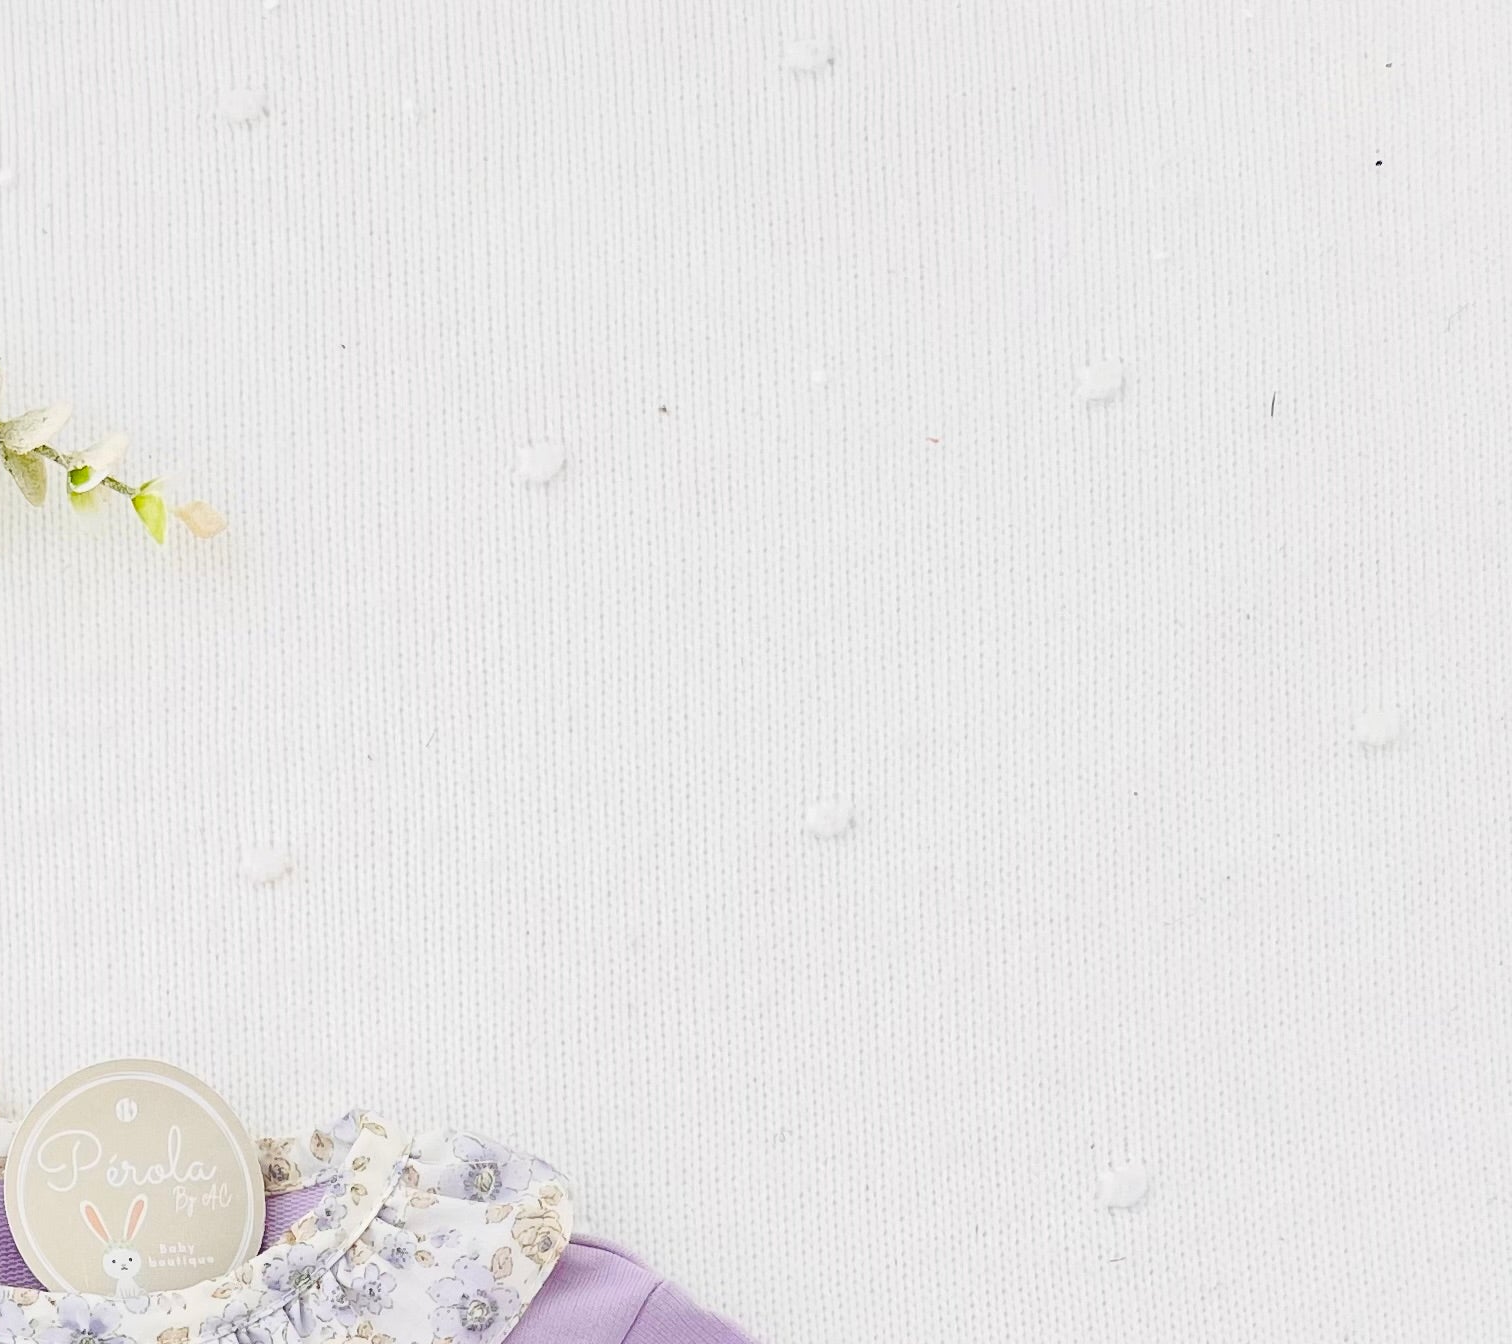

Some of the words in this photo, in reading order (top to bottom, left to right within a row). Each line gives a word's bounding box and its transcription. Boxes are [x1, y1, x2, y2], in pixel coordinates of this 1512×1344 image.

[37, 1125, 217, 1193] Pérola
[172, 1185, 197, 1218] By
[148, 1255, 215, 1269] boutique
